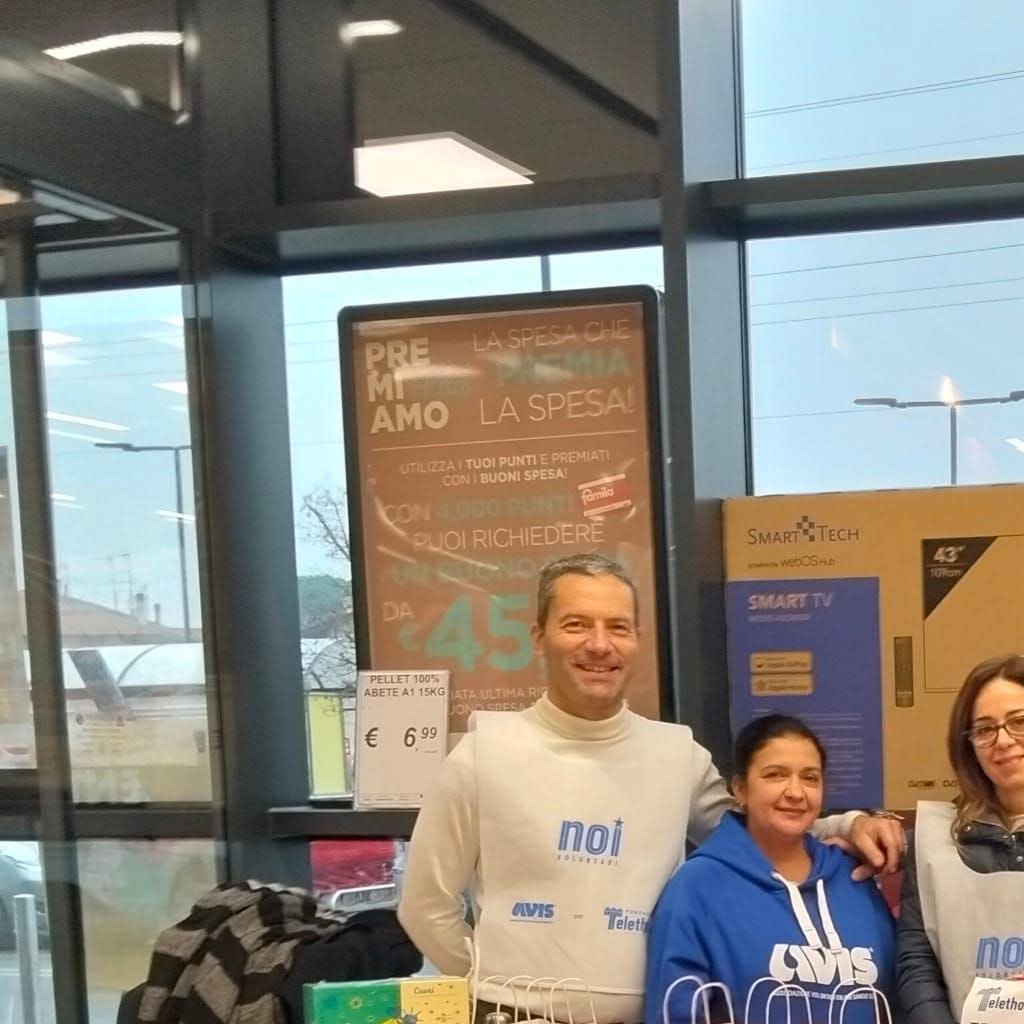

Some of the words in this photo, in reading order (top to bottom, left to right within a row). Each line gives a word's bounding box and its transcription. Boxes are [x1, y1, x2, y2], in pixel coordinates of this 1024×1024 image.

[473, 331, 497, 353] LA
[504, 323, 578, 350] SPESA
[583, 318, 633, 344] CHE
[365, 337, 431, 370] PRE
[367, 371, 405, 403] MI
[370, 400, 450, 434] AMO
[479, 397, 521, 426] LA
[527, 383, 636, 424] SPESA!
[400, 461, 456, 475] UTILIZZA
[466, 457, 496, 471] TUOI
[499, 455, 537, 469] PUNTI
[552, 449, 612, 466] PREMIATI
[443, 473, 470, 487] CON
[480, 470, 521, 485] BUONI
[523, 468, 568, 483] SPESA!
[472, 521, 606, 550] RICHIEDERE
[747, 593, 811, 611] SMART
[813, 591, 836, 609] TV
[363, 687, 400, 698] ABETE
[401, 686, 416, 698] A1
[418, 686, 447, 698] 15KG
[369, 673, 411, 685] PELLET
[413, 672, 441, 685] 100%
[364, 726, 380, 749] €
[558, 816, 625, 858] noi
[511, 901, 555, 919] AVIS
